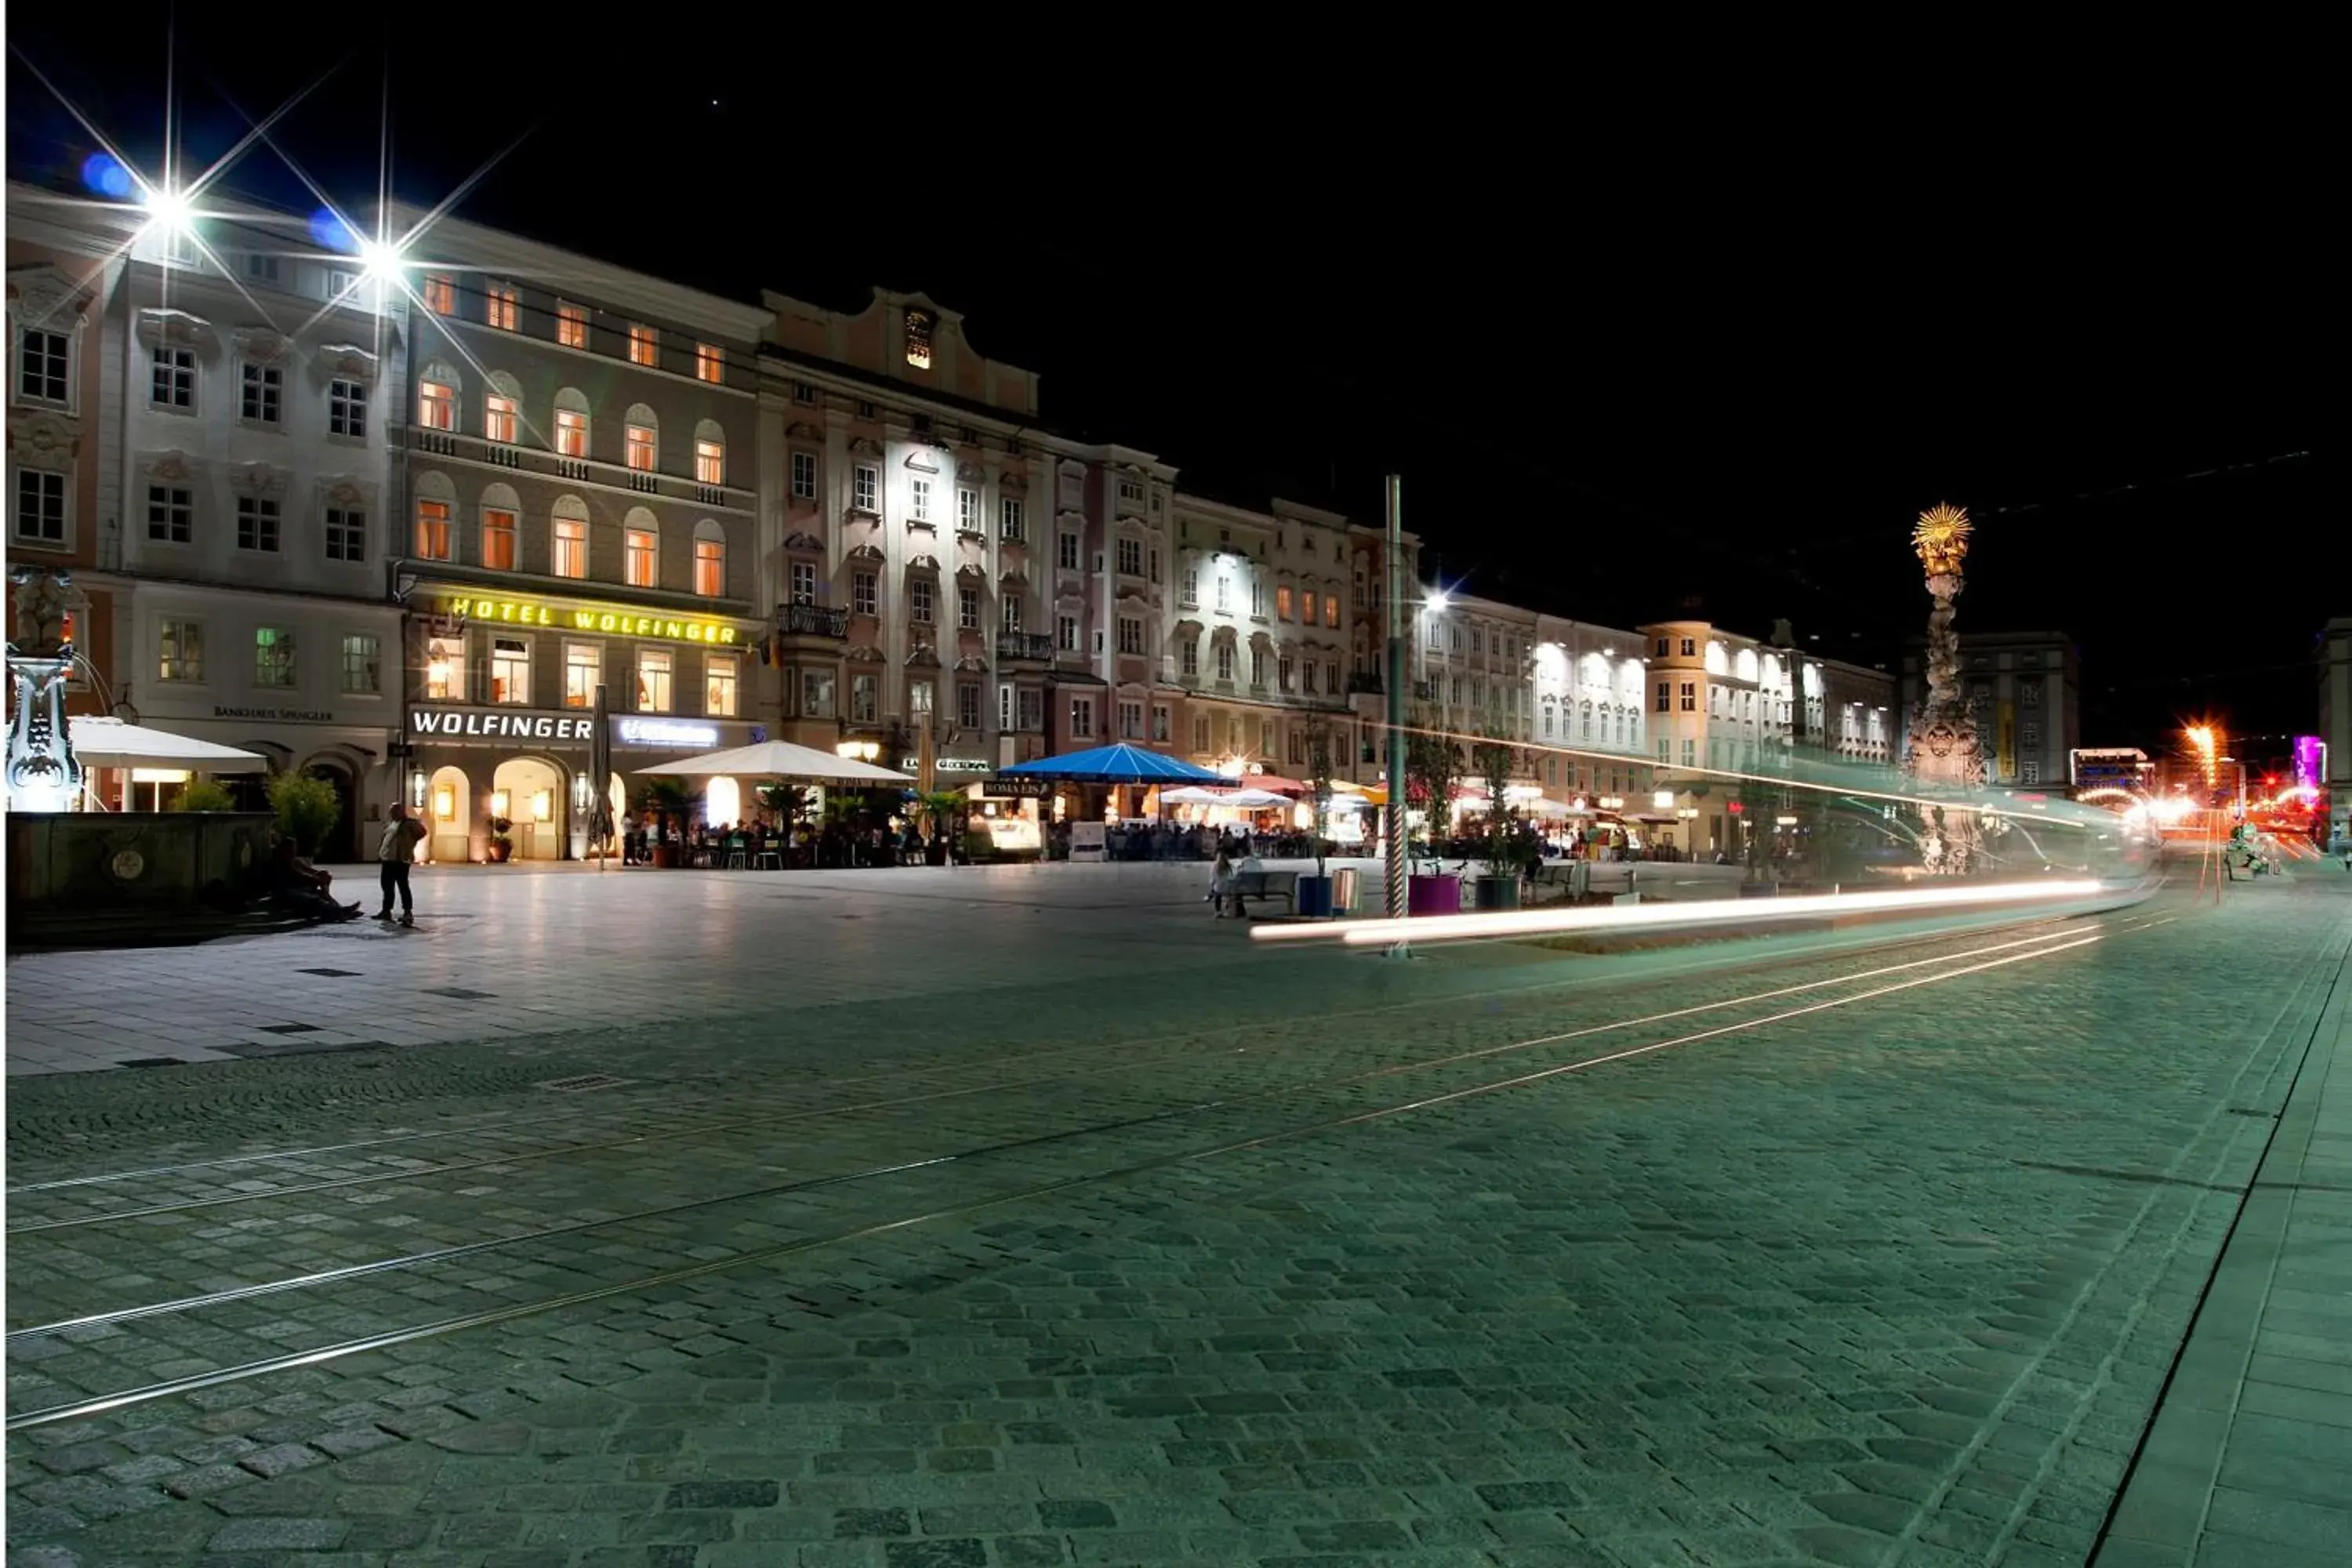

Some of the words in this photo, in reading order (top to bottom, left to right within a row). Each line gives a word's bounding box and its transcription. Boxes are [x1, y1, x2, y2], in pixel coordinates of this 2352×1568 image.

[452, 598, 550, 625] HOTEL
[575, 612, 735, 643] WOLFINGER
[413, 712, 593, 739] WOLFINGER
